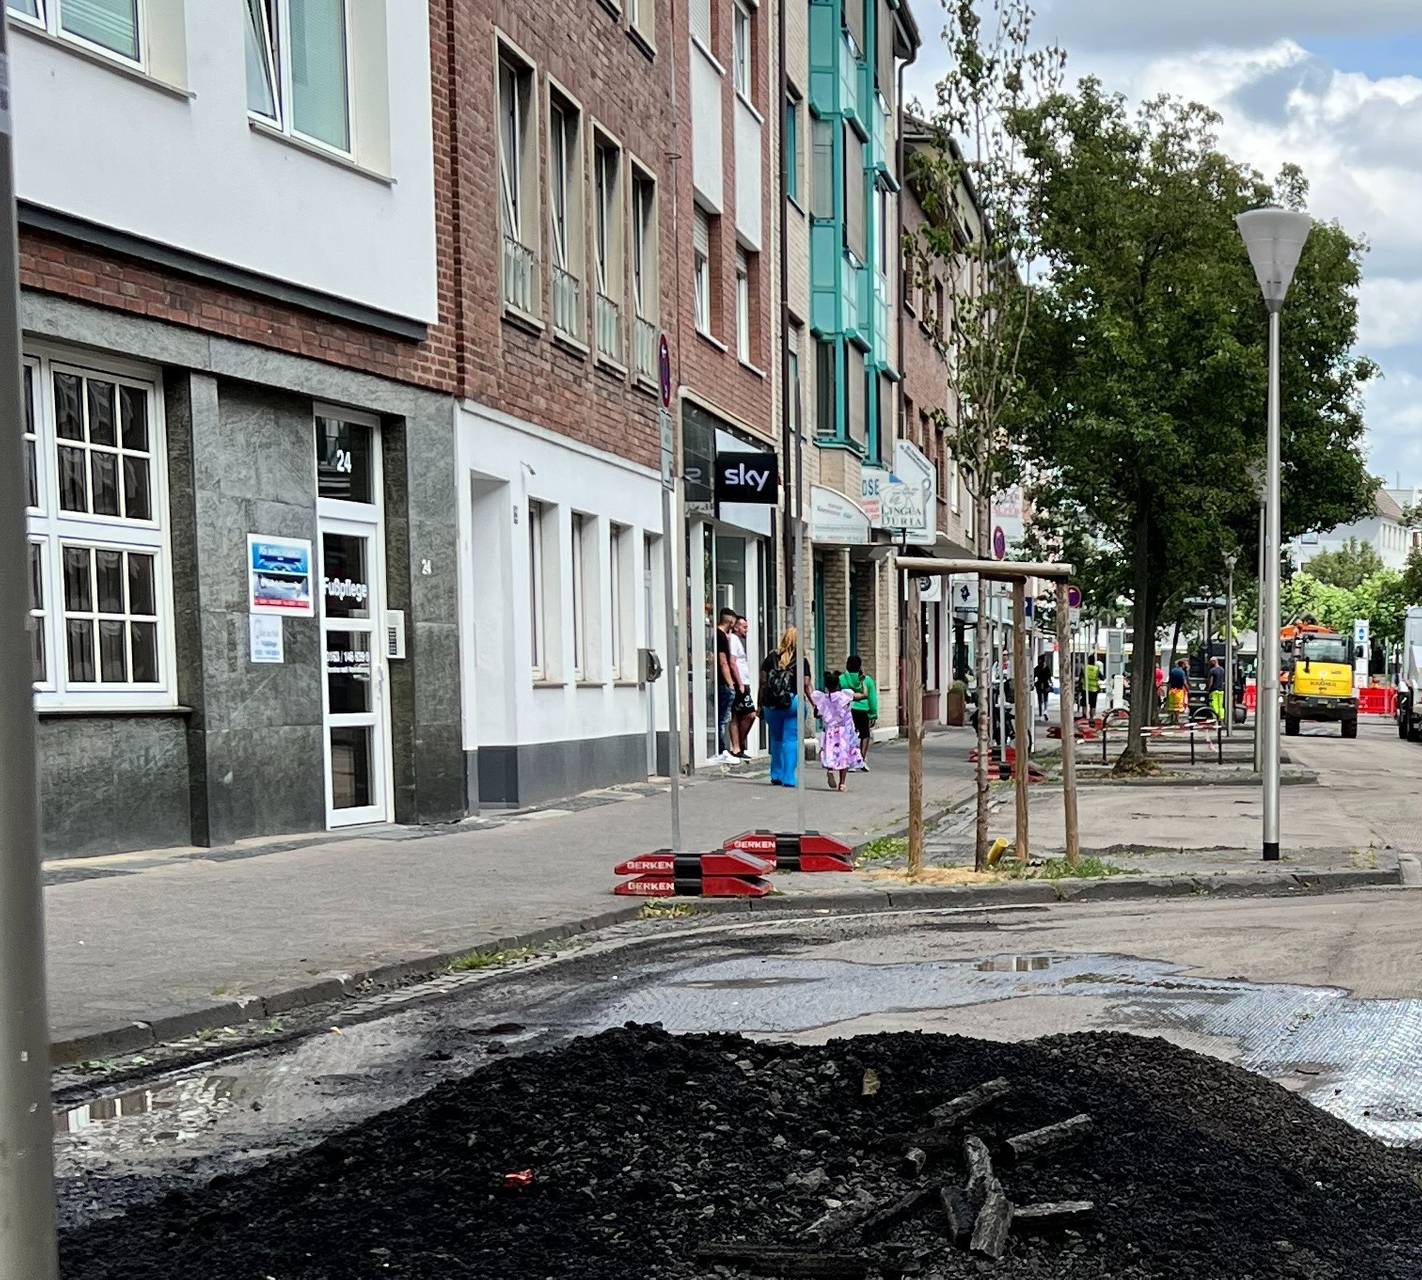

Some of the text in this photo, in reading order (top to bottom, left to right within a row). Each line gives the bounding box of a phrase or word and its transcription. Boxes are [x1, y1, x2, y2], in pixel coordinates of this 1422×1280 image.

[336, 449, 352, 473] 24
[725, 463, 770, 492] sky
[421, 559, 432, 575] 24
[734, 840, 776, 849] GERKEN
[626, 861, 674, 870] GERKEN
[627, 882, 675, 891] GERKEN
